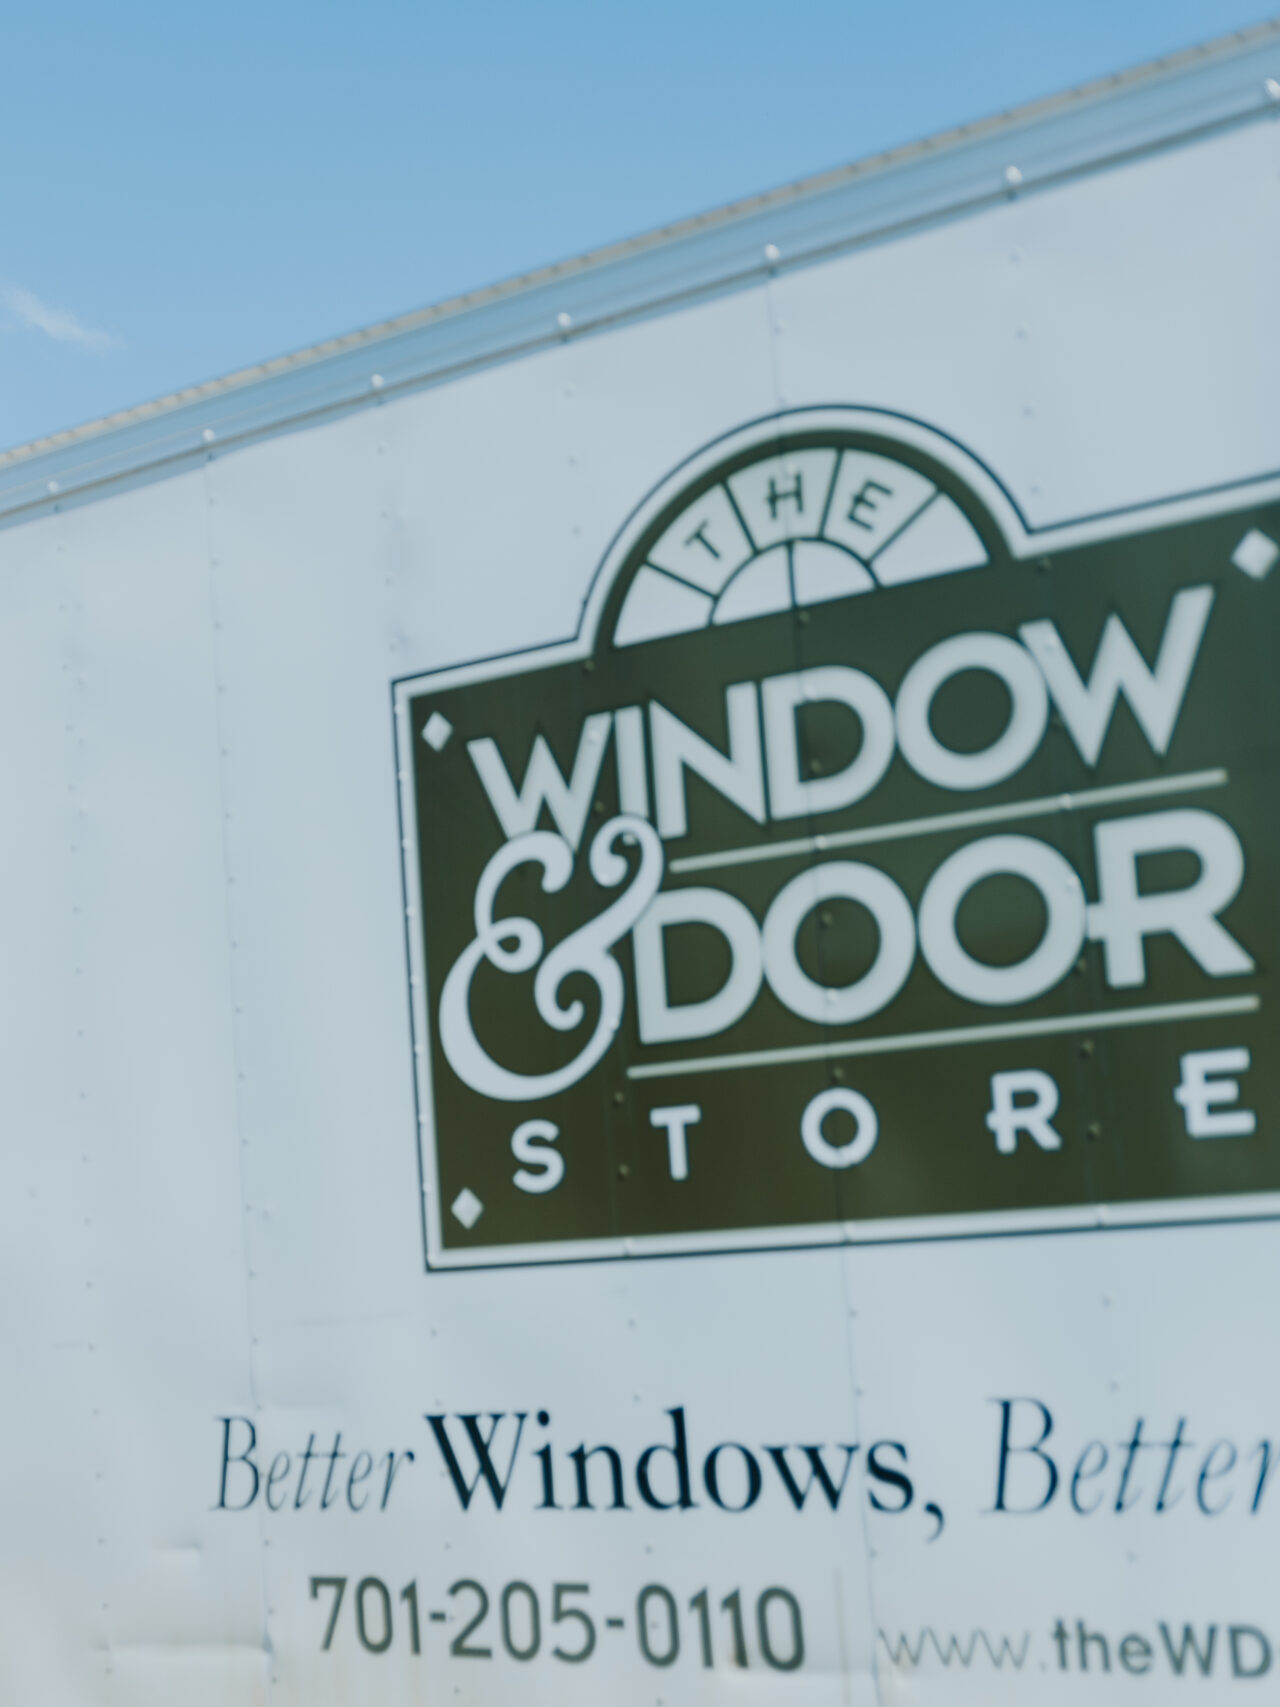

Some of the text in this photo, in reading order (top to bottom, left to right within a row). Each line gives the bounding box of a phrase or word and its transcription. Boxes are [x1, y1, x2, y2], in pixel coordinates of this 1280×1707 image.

[684, 471, 893, 561] THE
[466, 584, 1216, 852] WINDOW
[439, 807, 1257, 1102] & DOOR
[510, 1046, 1258, 1194] STORE
[209, 1397, 1280, 1542] Better Windows, Better
[308, 1575, 1280, 1679] 701-205-0110 www.theWD
